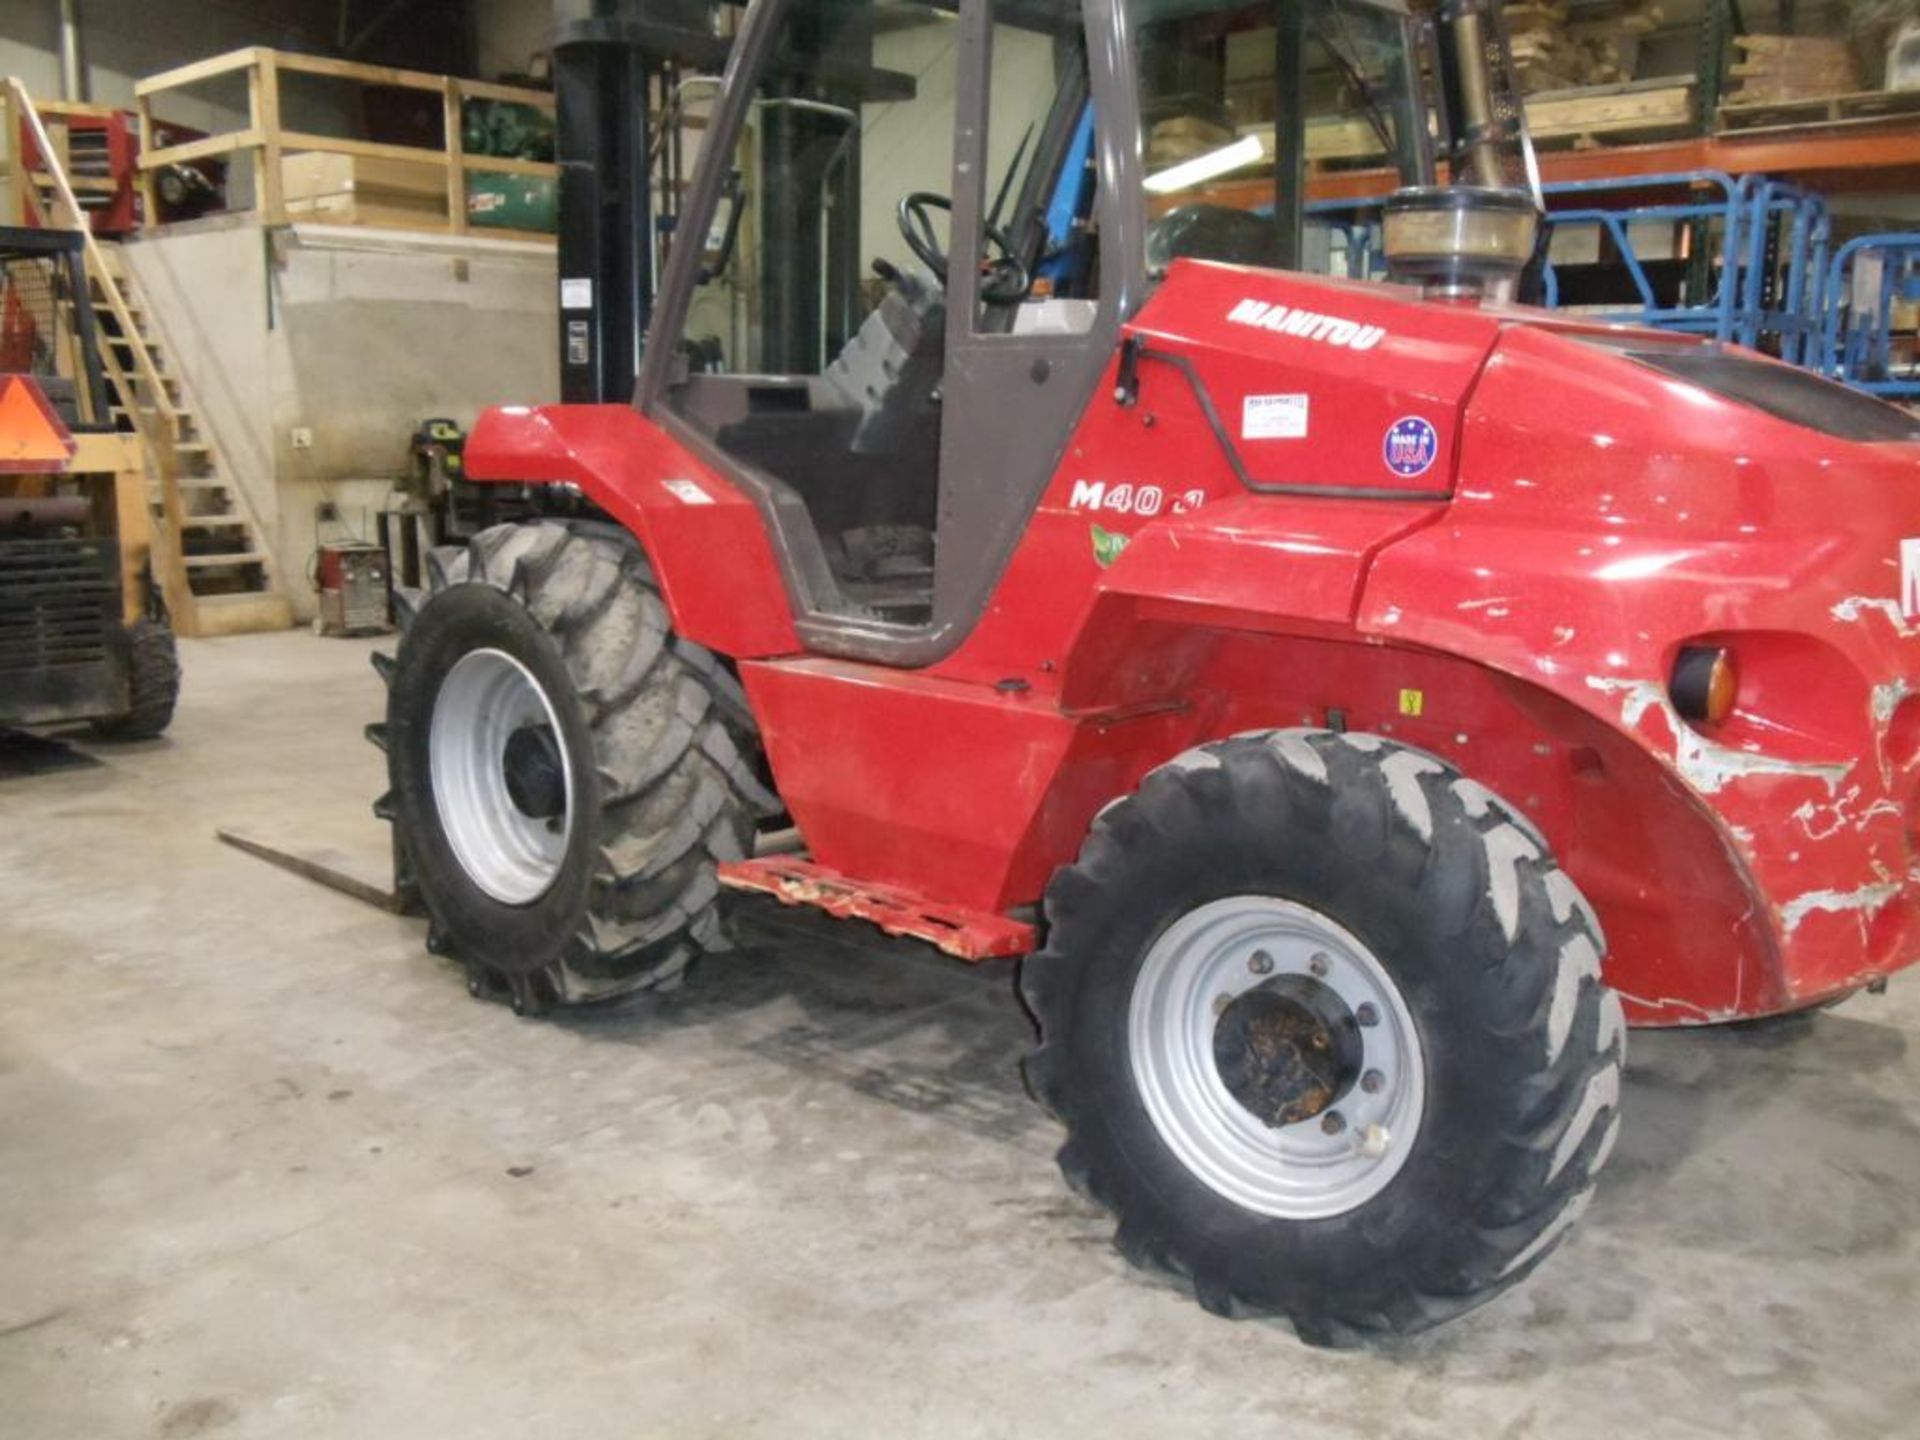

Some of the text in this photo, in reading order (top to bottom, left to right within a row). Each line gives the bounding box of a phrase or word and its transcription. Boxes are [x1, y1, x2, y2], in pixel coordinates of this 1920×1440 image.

[1226, 298, 1386, 351] MANITOU
[1391, 434, 1430, 446] MADE IN
[1390, 444, 1428, 465] USA
